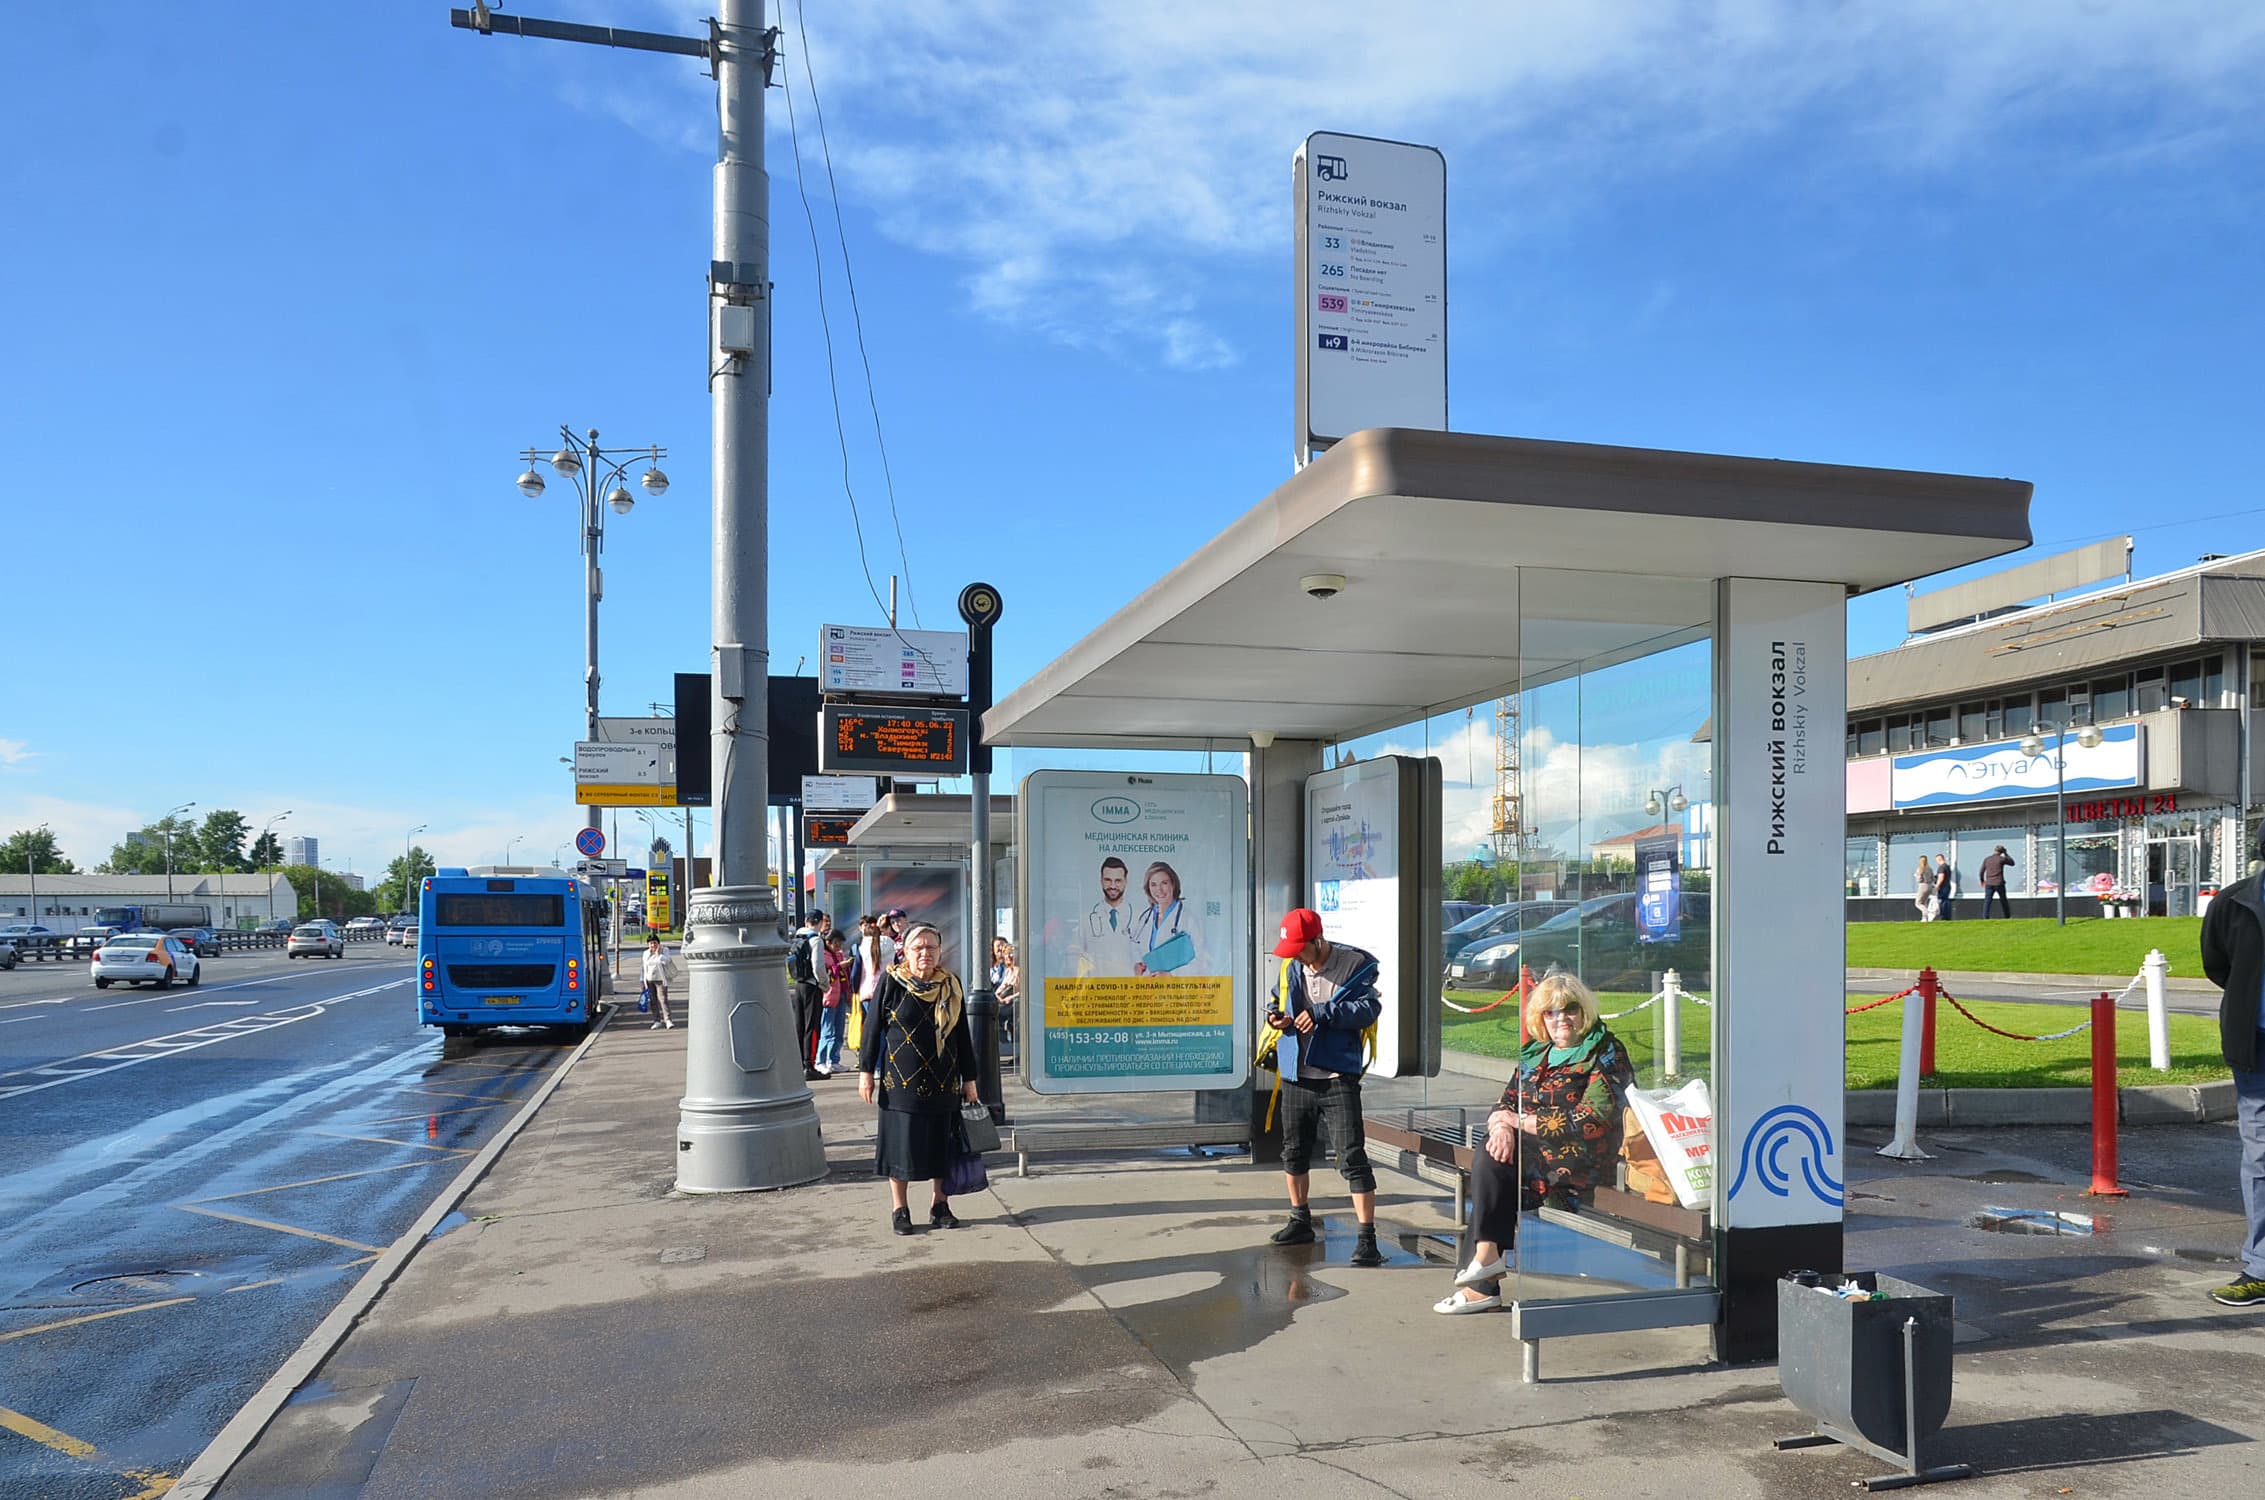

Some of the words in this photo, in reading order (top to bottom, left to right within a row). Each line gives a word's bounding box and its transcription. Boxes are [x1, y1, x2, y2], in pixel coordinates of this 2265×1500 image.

[1318, 190, 1368, 207] Рижский
[1370, 199, 1407, 212] вокзал
[1318, 205, 1350, 217] Rizhskiy
[1352, 209, 1376, 219] Vokzal
[1324, 237, 1340, 248] 33
[1322, 264, 1344, 276] 265
[1322, 298, 1344, 310] 539
[1792, 642, 1806, 697] Vokzal
[1772, 641, 1786, 732] вокзал
[887, 720, 911, 728] 17:40
[1793, 704, 1809, 774] Rizhskiy
[1767, 740, 1786, 855] Рижский
[1102, 804, 1130, 815] IMMA
[2066, 796, 2144, 823] ЦВЕТЫ
[2152, 794, 2176, 814] 24
[1085, 832, 1148, 842] МЕДИЦИНСКАЯ
[1150, 832, 1189, 842] КЛИНИКА
[1099, 844, 1110, 853] НА
[1112, 844, 1176, 854] АЛЕКСЕЕВСКОЙ
[1135, 982, 1164, 990] ОНЛАЙН
[1069, 1032, 1129, 1044] 153-92-08
[1058, 1056, 1094, 1064] НАЛИЧИИ
[1096, 1053, 1174, 1062] ПРОТИВОПОКАЗАНИЙ
[1176, 1052, 1224, 1062] НЕОБХОДИМО
[1054, 1062, 1150, 1072] ПРОКОНСУЛЬТИРОВАТЬСЯ
[1151, 1062, 1161, 1070] СО
